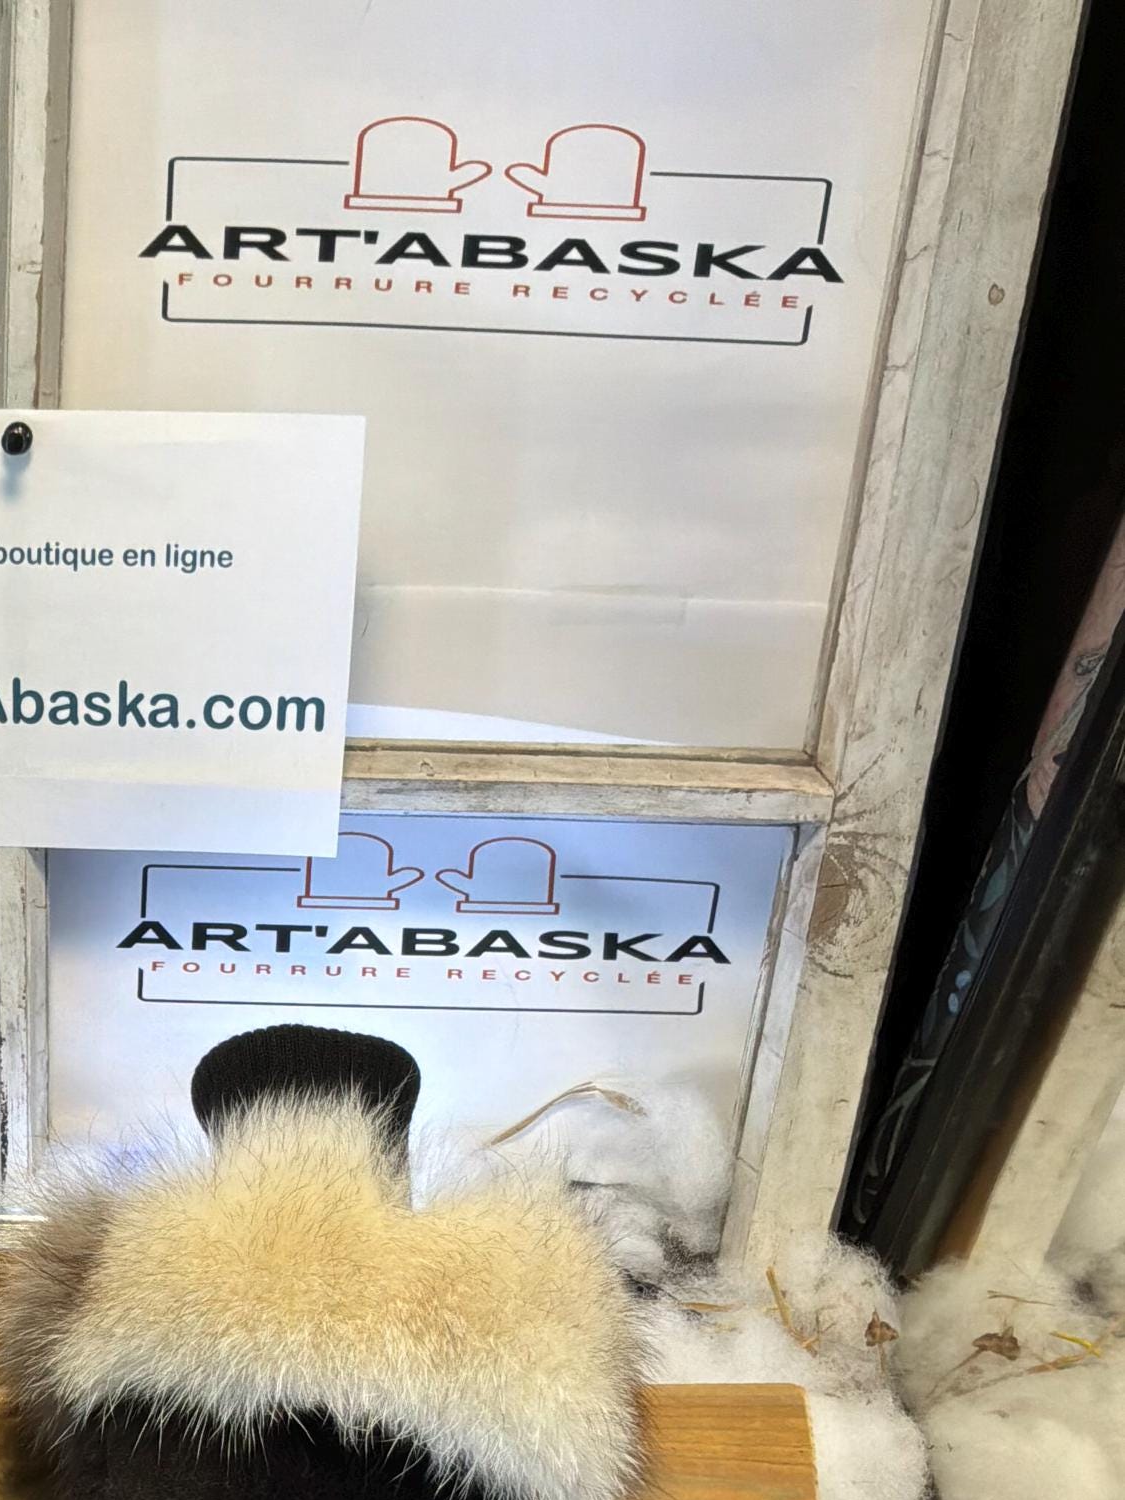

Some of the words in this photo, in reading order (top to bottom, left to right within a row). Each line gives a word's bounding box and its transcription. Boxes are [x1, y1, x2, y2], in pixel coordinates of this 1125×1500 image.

[139, 225, 844, 284] ART'ABASKA
[176, 271, 472, 296] FOURRURE
[512, 282, 800, 310] RECYCLÉE
[122, 548, 156, 567] en
[165, 543, 233, 574] ligne
[116, 920, 731, 965] ART'ABASKA
[151, 960, 410, 981] FOURRURE
[447, 967, 693, 986] RECYCLÉE
